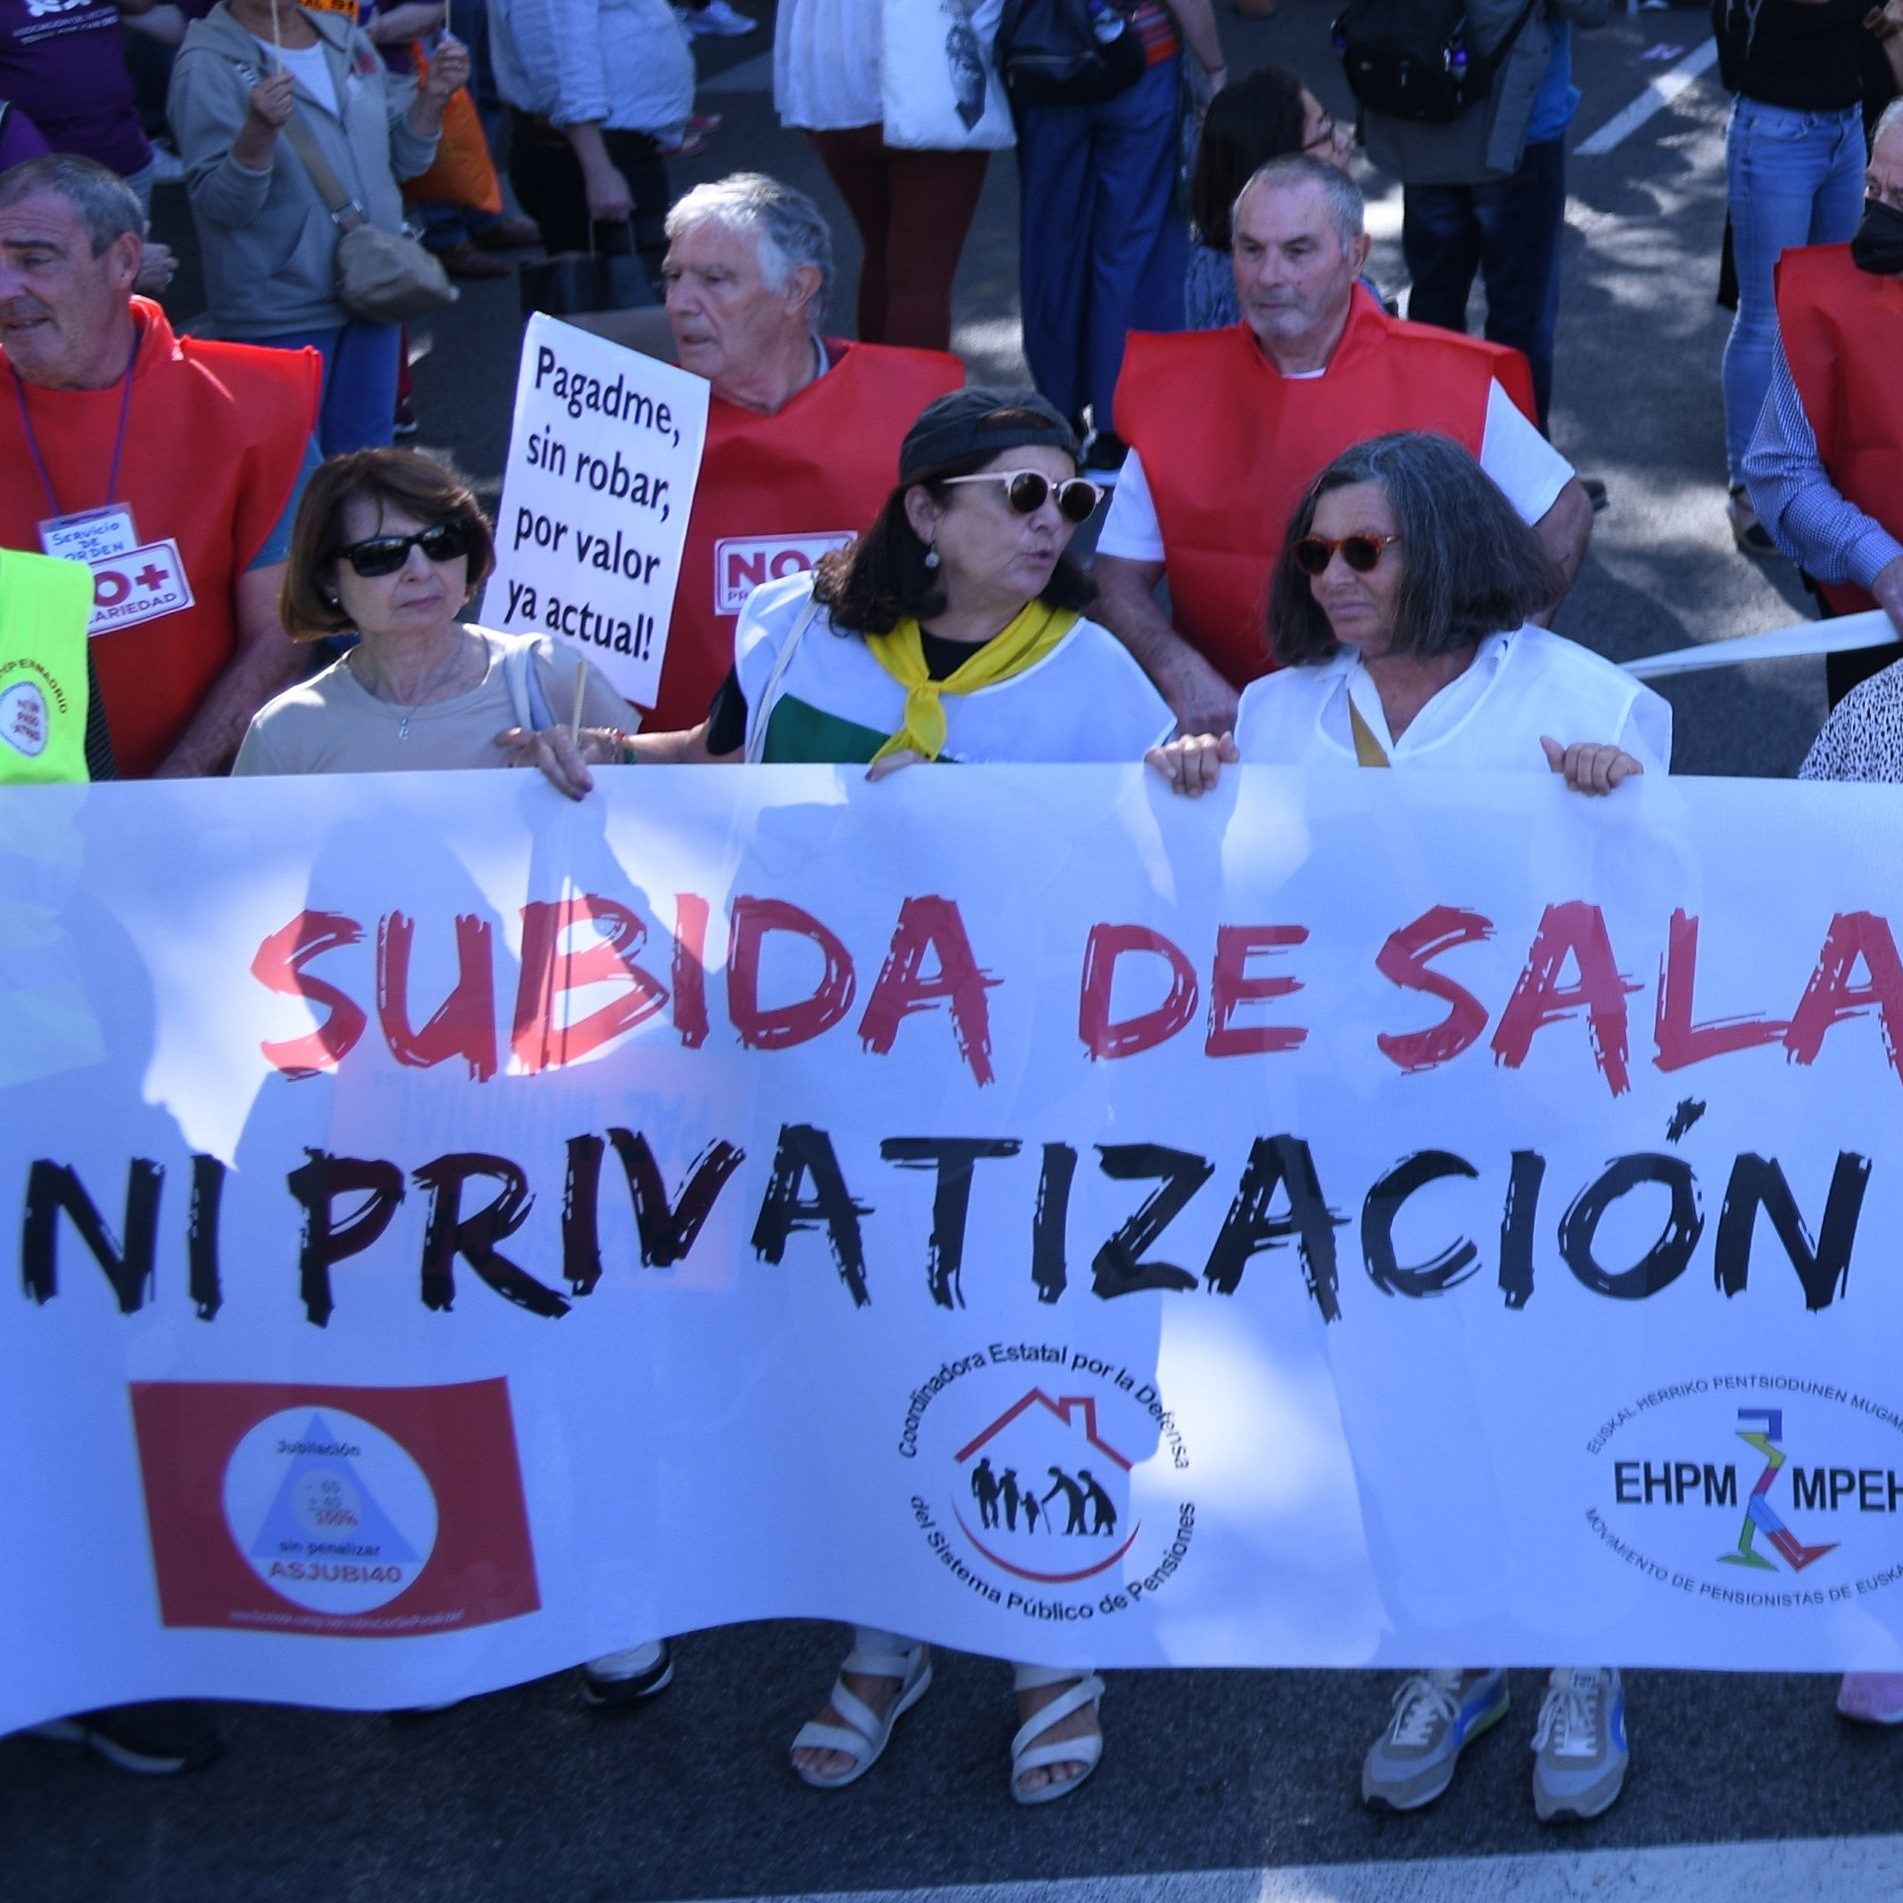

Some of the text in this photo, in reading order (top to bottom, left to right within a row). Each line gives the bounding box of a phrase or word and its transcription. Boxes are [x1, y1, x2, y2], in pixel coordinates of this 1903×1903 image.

[535, 345, 680, 448] Pagadme,
[526, 425, 670, 523] sin robar,
[513, 506, 660, 585] por valor
[504, 579, 654, 662] ya actual!
[249, 893, 1002, 1089] SUBIDA
[1080, 921, 1308, 1064] DE
[21, 1151, 226, 1322] NI
[288, 1102, 1873, 1326] PRIVATIZACIÓN
[899, 1343, 1189, 1470] Coordinadora Estatal por la Defensa
[1714, 1374, 1847, 1403] PENTSIODUNEN
[1614, 1461, 1737, 1507] EHPM
[909, 1495, 1195, 1621] del Sistema Público de Pensiones
[1672, 1574, 1853, 1608] DE PENSIONISTAS DE
